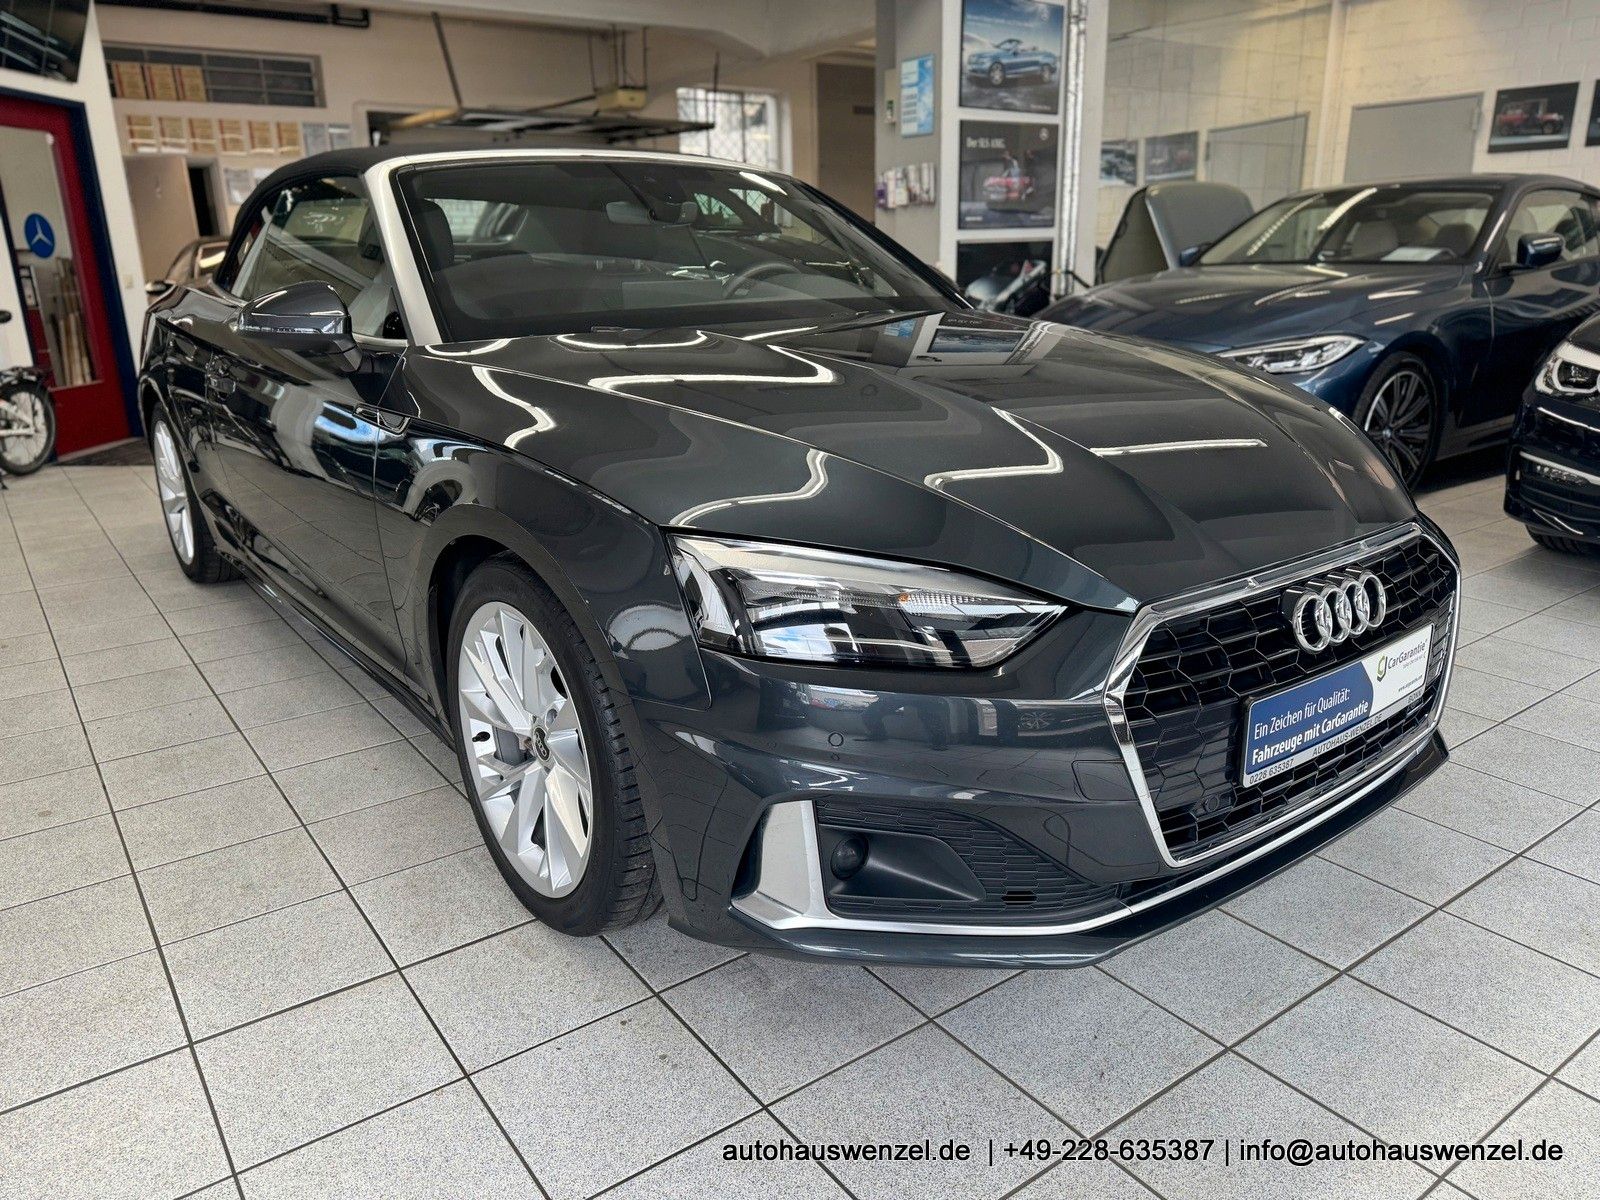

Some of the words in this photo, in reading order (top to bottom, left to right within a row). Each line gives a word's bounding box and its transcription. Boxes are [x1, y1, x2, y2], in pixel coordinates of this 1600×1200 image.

[1252, 733, 1302, 765] Fahrzeuge
[1304, 723, 1320, 743] mit
[1321, 700, 1369, 734] CarGarantie
[1254, 723, 1268, 740] Ein
[1270, 710, 1302, 734] Zeichen
[1304, 702, 1316, 720] für
[1317, 688, 1350, 713] Qualität:
[1249, 769, 1266, 784] 0228
[1269, 758, 1294, 776] 635387
[1312, 713, 1382, 757] AUTOHAUS-WENZEL.DE
